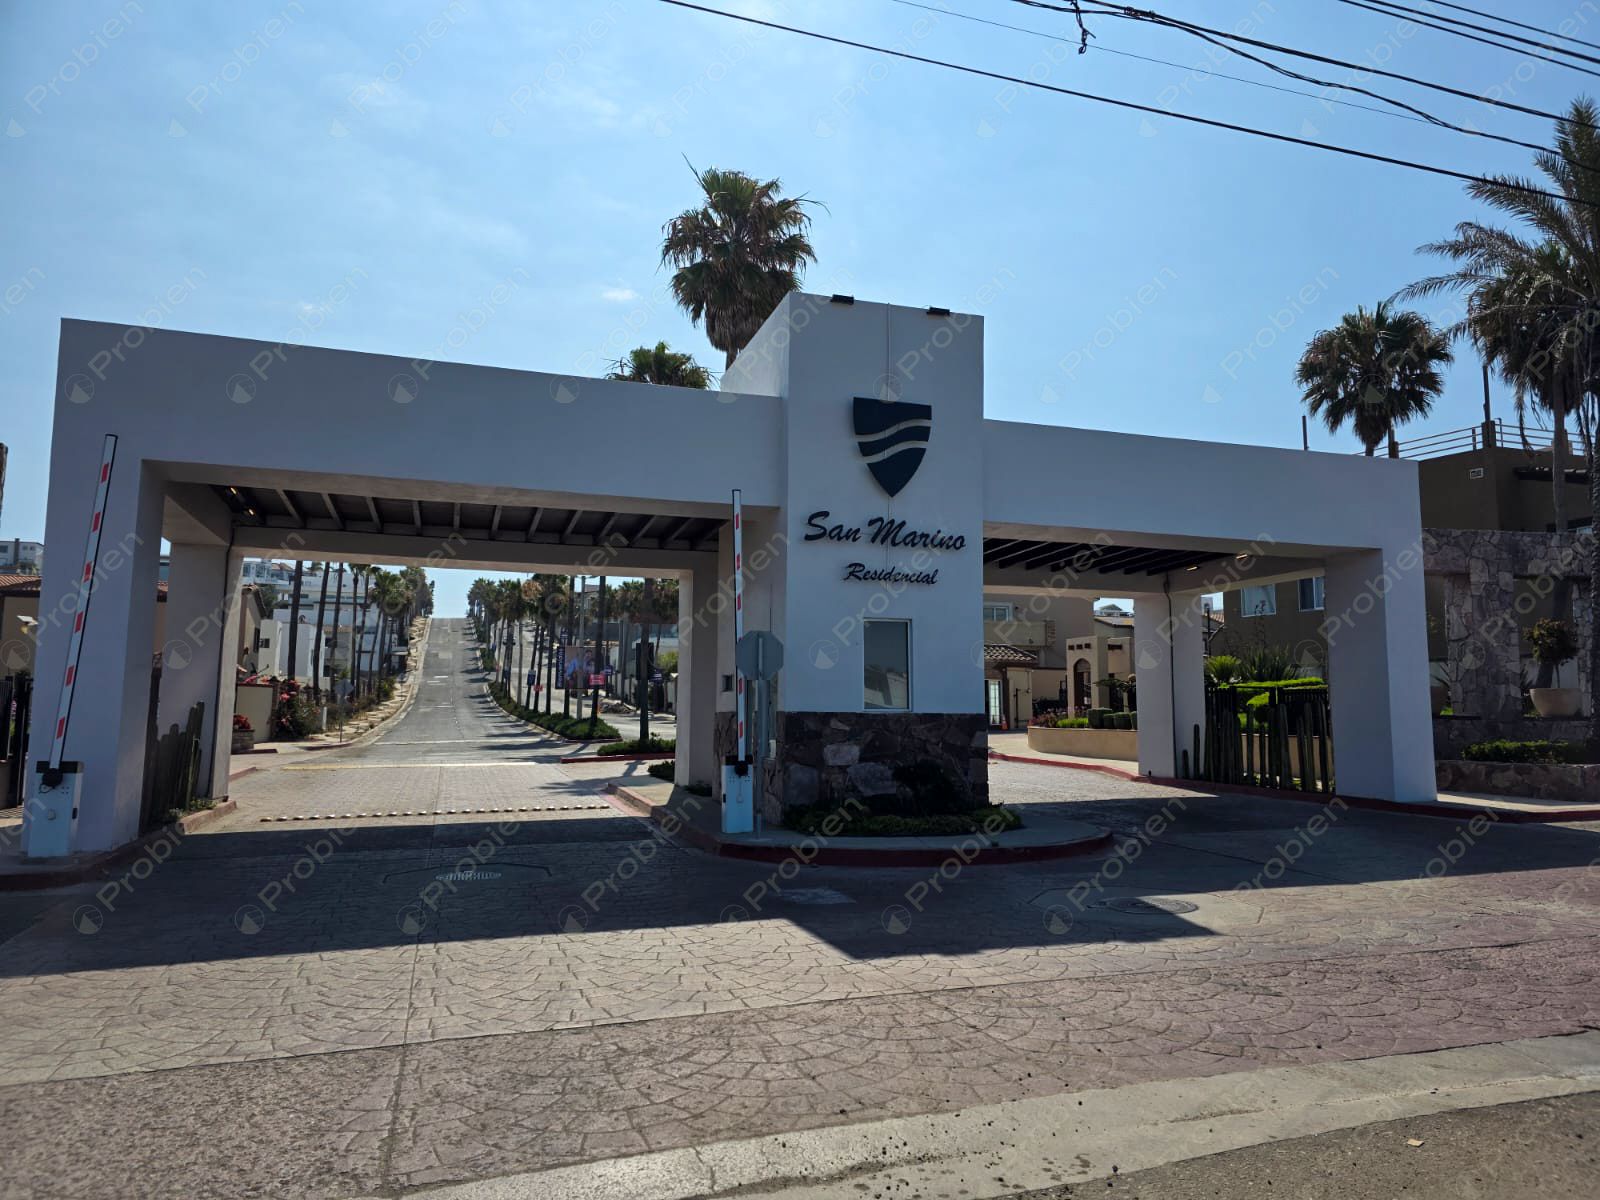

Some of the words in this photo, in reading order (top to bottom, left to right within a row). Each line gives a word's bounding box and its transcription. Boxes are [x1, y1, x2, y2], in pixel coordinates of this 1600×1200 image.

[804, 511, 862, 542] San
[867, 517, 966, 550] Marino
[843, 563, 938, 585] Residencial
